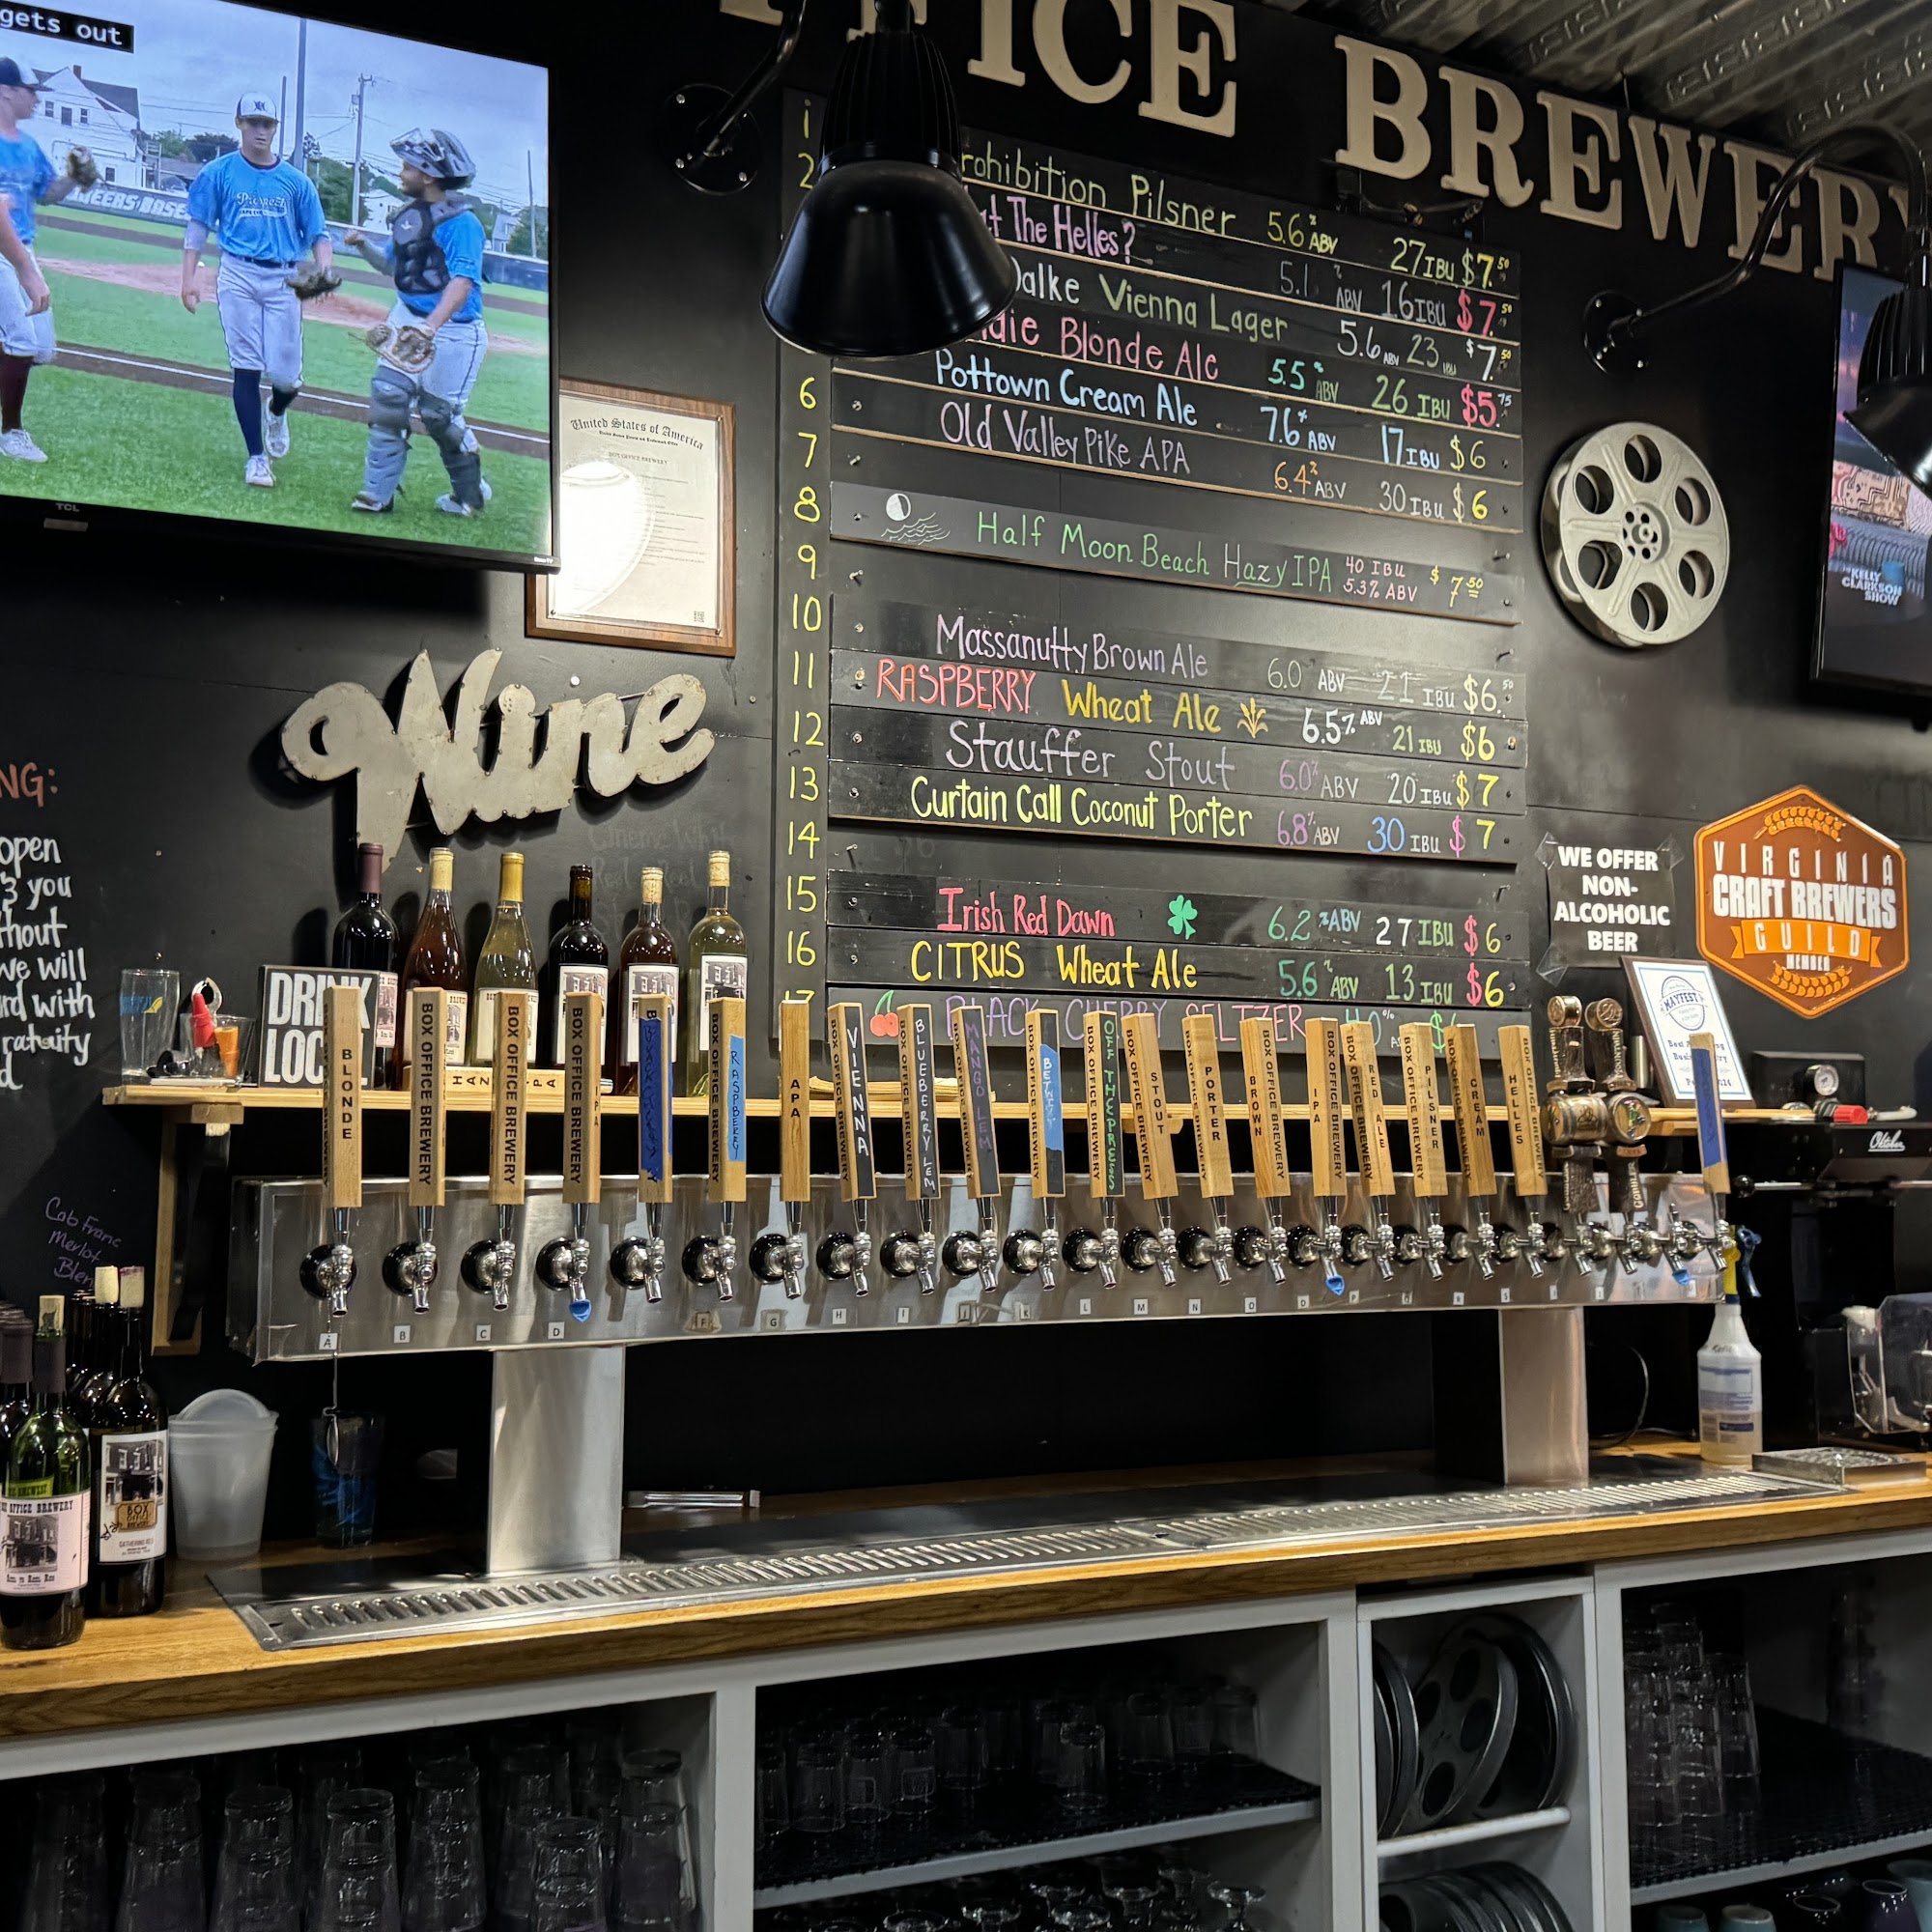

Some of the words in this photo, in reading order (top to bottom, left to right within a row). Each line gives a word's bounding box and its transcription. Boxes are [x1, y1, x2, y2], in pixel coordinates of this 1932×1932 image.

[0, 9, 61, 34] gets
[77, 24, 123, 45] out
[798, 153, 815, 189] 2
[961, 141, 1106, 209] rohibition
[1131, 174, 1236, 236] Pilsner
[1309, 233, 1338, 255] ABV
[1007, 196, 1047, 244] The
[1098, 273, 1197, 328] Vienna
[1211, 293, 1289, 343] Lager
[1337, 319, 1381, 360] 5.6
[1406, 334, 1439, 368] 23
[1062, 317, 1163, 369] Blonde
[1175, 340, 1219, 381] Ale
[1316, 379, 1340, 403] ABV
[1372, 375, 1408, 414] 26
[1417, 394, 1451, 421] IBU
[800, 377, 817, 409] 6
[936, 348, 1051, 402] Pottown
[1060, 369, 1146, 417] Cream
[1156, 384, 1198, 426] Ale
[1308, 430, 1337, 451] ABV
[1381, 425, 1404, 466] 17
[1406, 447, 1440, 470] IBU
[570, 418, 608, 431] United
[611, 417, 646, 432] States
[662, 425, 703, 450] America
[798, 433, 818, 468] 7
[941, 401, 992, 451] Old
[1004, 410, 1078, 465] Valley
[1085, 426, 1131, 469] Pike
[1140, 436, 1191, 475] APA
[1315, 480, 1347, 499] ABV
[1379, 481, 1406, 513] 30
[1409, 497, 1445, 520] IBU
[55, 502, 80, 513] TCL
[794, 486, 821, 523] 8
[797, 545, 817, 580] 9
[978, 511, 1046, 547] Half
[1061, 524, 1133, 564] Moon
[1141, 533, 1209, 575] Beach
[1224, 544, 1288, 588] Hazy
[1293, 554, 1332, 592] IPA
[1346, 555, 1364, 575] 40
[1371, 560, 1406, 578] IBU
[1343, 579, 1380, 598] 5.3%
[1385, 583, 1418, 602] ABV
[1841, 577, 1903, 597] CLARKSON
[1851, 568, 1881, 583] KELLY
[793, 593, 821, 632] 10
[1864, 590, 1900, 607] SHOW
[794, 650, 813, 689] 11
[936, 613, 1088, 674] Massanutty
[1094, 633, 1165, 673] Brown
[1172, 642, 1208, 679] Ale
[1267, 658, 1302, 690] 6.0
[1318, 668, 1345, 693] ABV
[1423, 687, 1455, 709] IBU
[876, 658, 1036, 714] RASPBERRY
[1062, 679, 1152, 724] Wheat
[1173, 692, 1221, 733] Ale
[1360, 710, 1382, 726] ABV
[1392, 725, 1413, 753] 21
[1419, 738, 1442, 755] IBU
[793, 711, 824, 746] 12
[281, 649, 716, 873] Wine
[946, 721, 1115, 778] Stauffer
[1146, 740, 1236, 791] Stout
[1321, 774, 1359, 799] ABV
[1388, 773, 1416, 804] 20
[1420, 788, 1452, 806] IBU
[789, 766, 820, 802] 13
[910, 776, 1008, 822] Curtain
[1016, 783, 1062, 823] Call
[1071, 787, 1158, 829] Coconut
[1169, 794, 1253, 838] Porter
[1313, 826, 1340, 846] ABV
[1368, 816, 1406, 853] 30
[1410, 835, 1440, 854] IBU
[788, 821, 820, 860] 14
[1557, 846, 1592, 867] WE
[1596, 848, 1659, 871] OFFER
[1713, 840, 1894, 886] VIRGINIA
[27, 875, 72, 911] you
[787, 875, 817, 912] 15
[1581, 875, 1638, 896] NON-
[1713, 873, 1785, 919] CRAFT
[1791, 881, 1897, 930] BREWERS
[937, 887, 1006, 933] Irish
[1014, 894, 1049, 936] Red
[1057, 899, 1115, 937] Dawn
[1376, 916, 1412, 947] 27
[1418, 920, 1453, 947] IBU
[1553, 901, 1670, 926] ALCOHOLIC
[788, 930, 816, 967] 16
[1587, 930, 1638, 952] BEER
[1754, 922, 1861, 957] GUILD
[37, 947, 87, 981] will
[911, 940, 1025, 982] CITRUS
[1057, 944, 1140, 989] Wheat
[1151, 948, 1198, 991] Ale
[1330, 977, 1359, 999] ABV
[1385, 963, 1415, 1001] 13
[1421, 981, 1453, 1005] IBU
[32, 981, 96, 1020] with
[421, 1003, 433, 1037] BOX
[1663, 992, 1699, 1011] MAYFEST
[572, 1008, 583, 1039] BOX
[264, 1029, 368, 1086] LOC
[420, 1040, 433, 1099] OFFICE
[571, 1046, 582, 1101] OFFICE
[342, 1049, 354, 1140] BLONDE
[790, 1079, 801, 1119] APA
[847, 1026, 869, 1157] VIENNA
[915, 1019, 932, 1151] BLUEBERRY
[1151, 1072, 1165, 1135] STOUT
[1205, 1066, 1221, 1141] PORTER
[1249, 1076, 1263, 1136] BROWN
[1312, 1088, 1321, 1123] IPA
[1369, 1065, 1378, 1098] RED
[1376, 1114, 1386, 1149] ALE
[1425, 1065, 1439, 1150] PILSNER
[1470, 1078, 1485, 1137] CREAM
[1509, 1075, 1523, 1145] HELLES
[418, 1105, 432, 1185] BREWERY
[569, 1107, 582, 1184] BREWERY
[48, 1230, 102, 1263] Merlot
[82, 1215, 123, 1248] Franc
[54, 1256, 95, 1287] Blen
